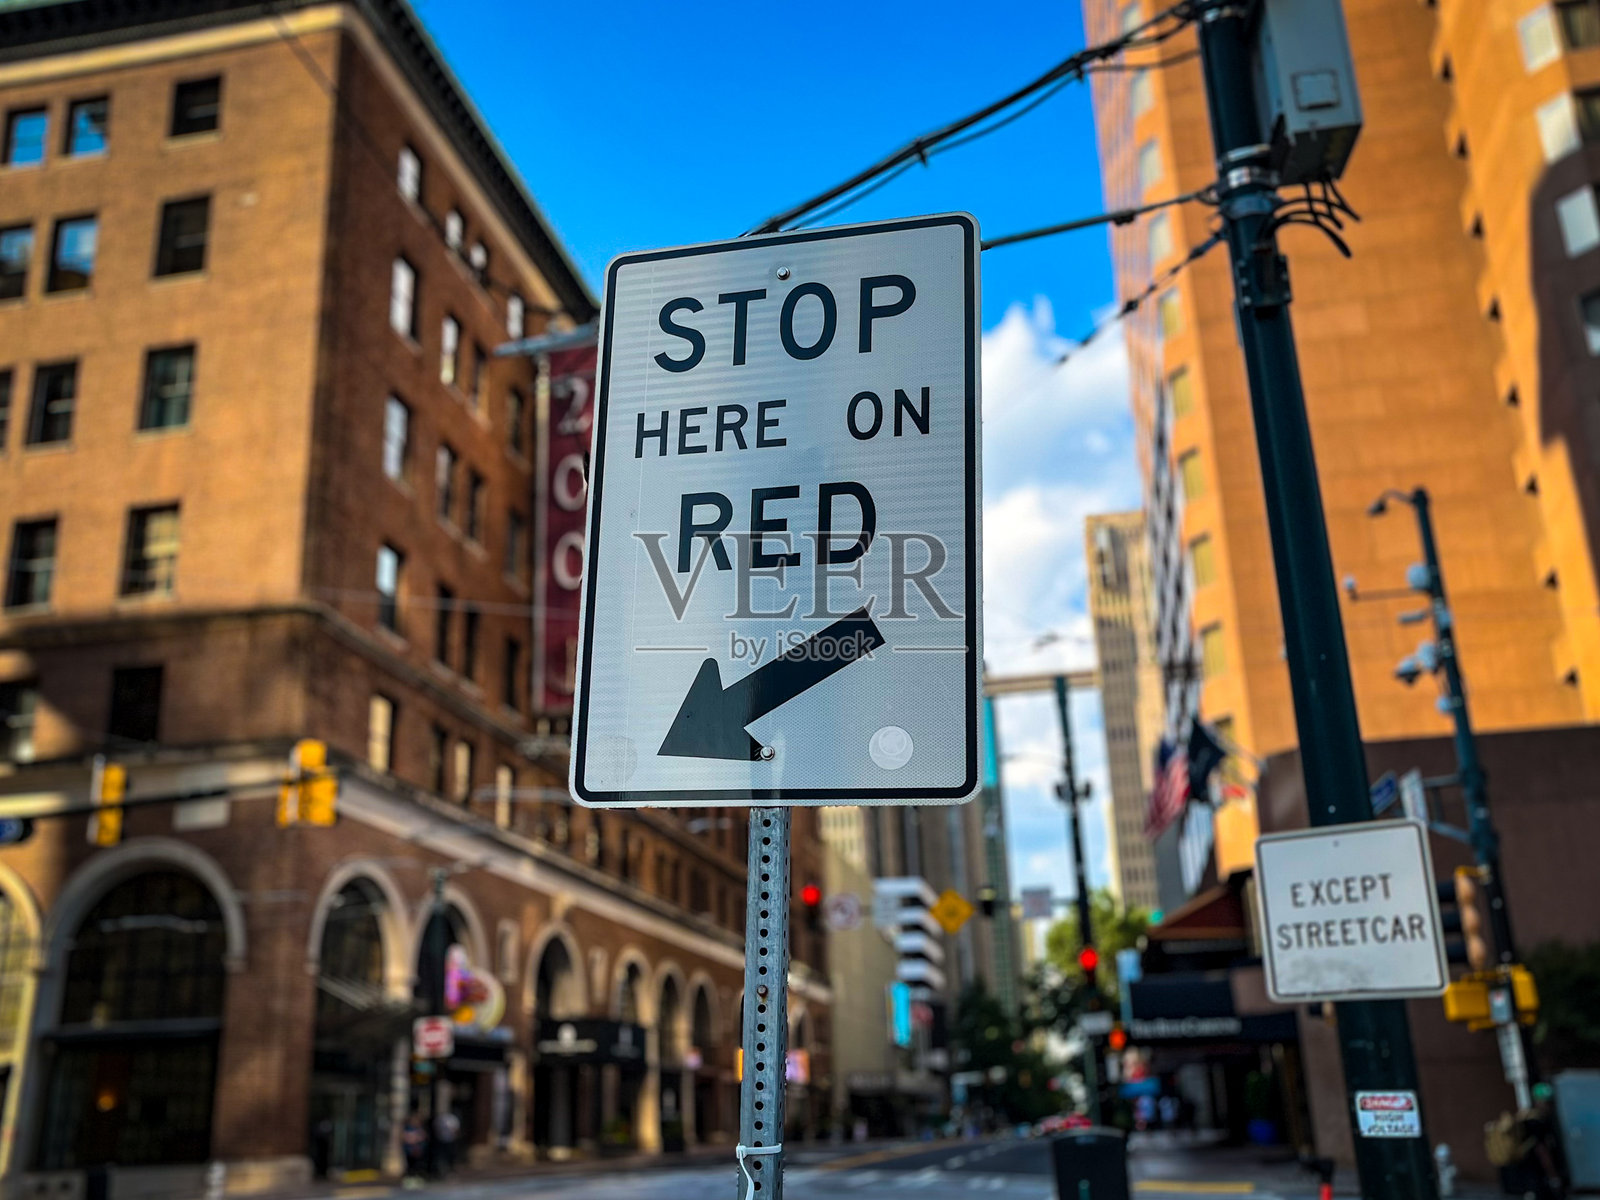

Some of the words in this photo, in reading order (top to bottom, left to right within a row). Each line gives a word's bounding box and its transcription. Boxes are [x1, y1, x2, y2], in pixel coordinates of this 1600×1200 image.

[654, 274, 917, 373] STOP
[635, 399, 787, 458] HERE
[847, 386, 930, 441] ON
[677, 481, 877, 573] RED
[1290, 872, 1391, 908] EXCEPT
[1277, 913, 1426, 950] STREETCAR
